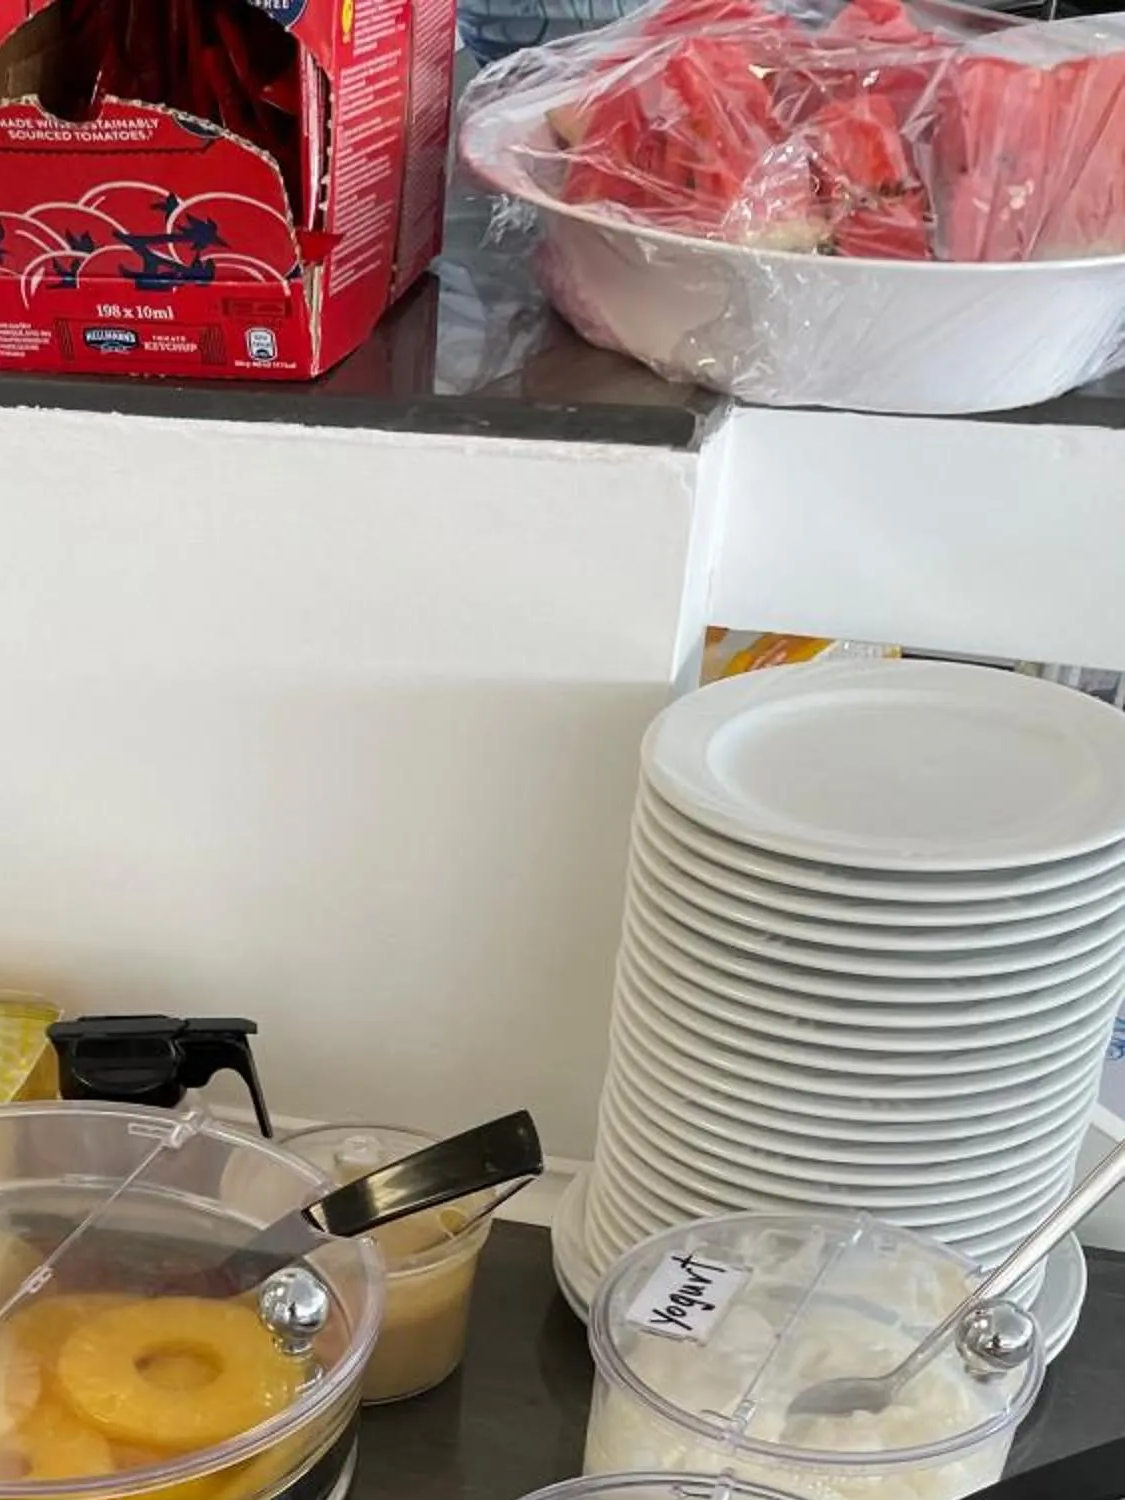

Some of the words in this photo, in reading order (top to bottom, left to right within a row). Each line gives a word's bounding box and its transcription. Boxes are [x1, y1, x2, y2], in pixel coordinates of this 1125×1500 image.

[7, 130, 72, 141] SOURCED
[96, 303, 122, 318] 198
[123, 307, 135, 319] x
[135, 305, 174, 320] 10ml
